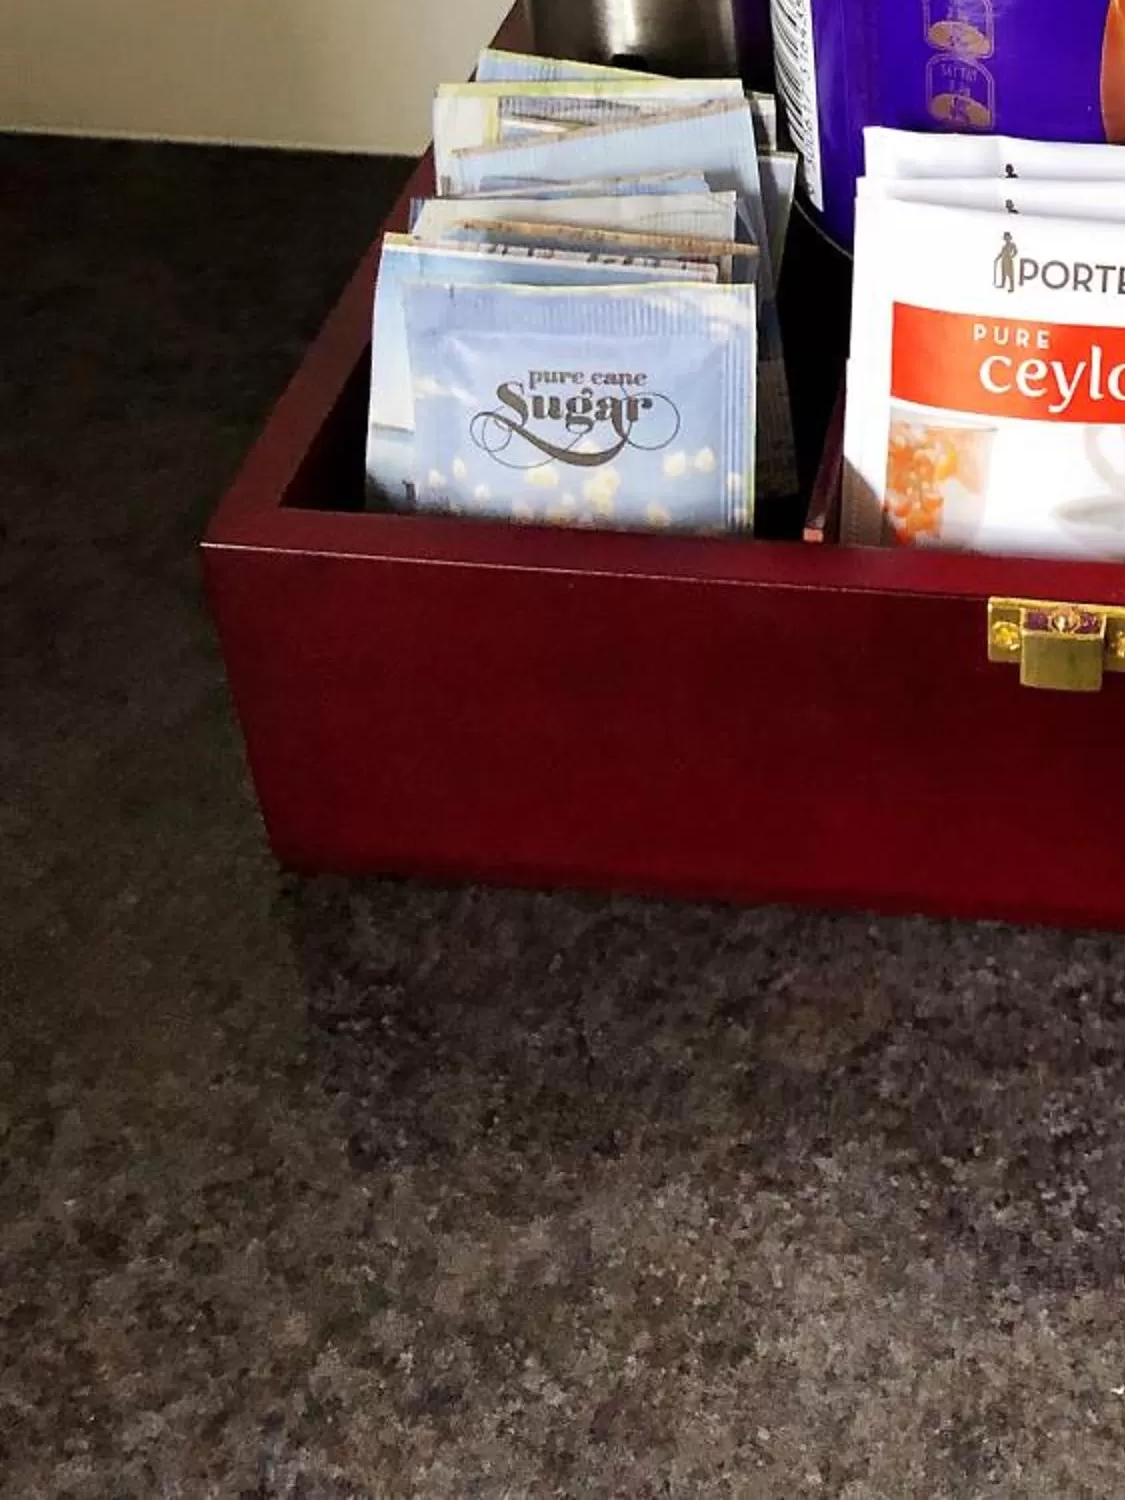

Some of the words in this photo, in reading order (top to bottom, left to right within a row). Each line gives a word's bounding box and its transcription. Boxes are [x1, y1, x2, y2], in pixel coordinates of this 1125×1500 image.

[973, 323, 1051, 350] PURE
[528, 369, 585, 390] pure
[591, 370, 648, 387] cane
